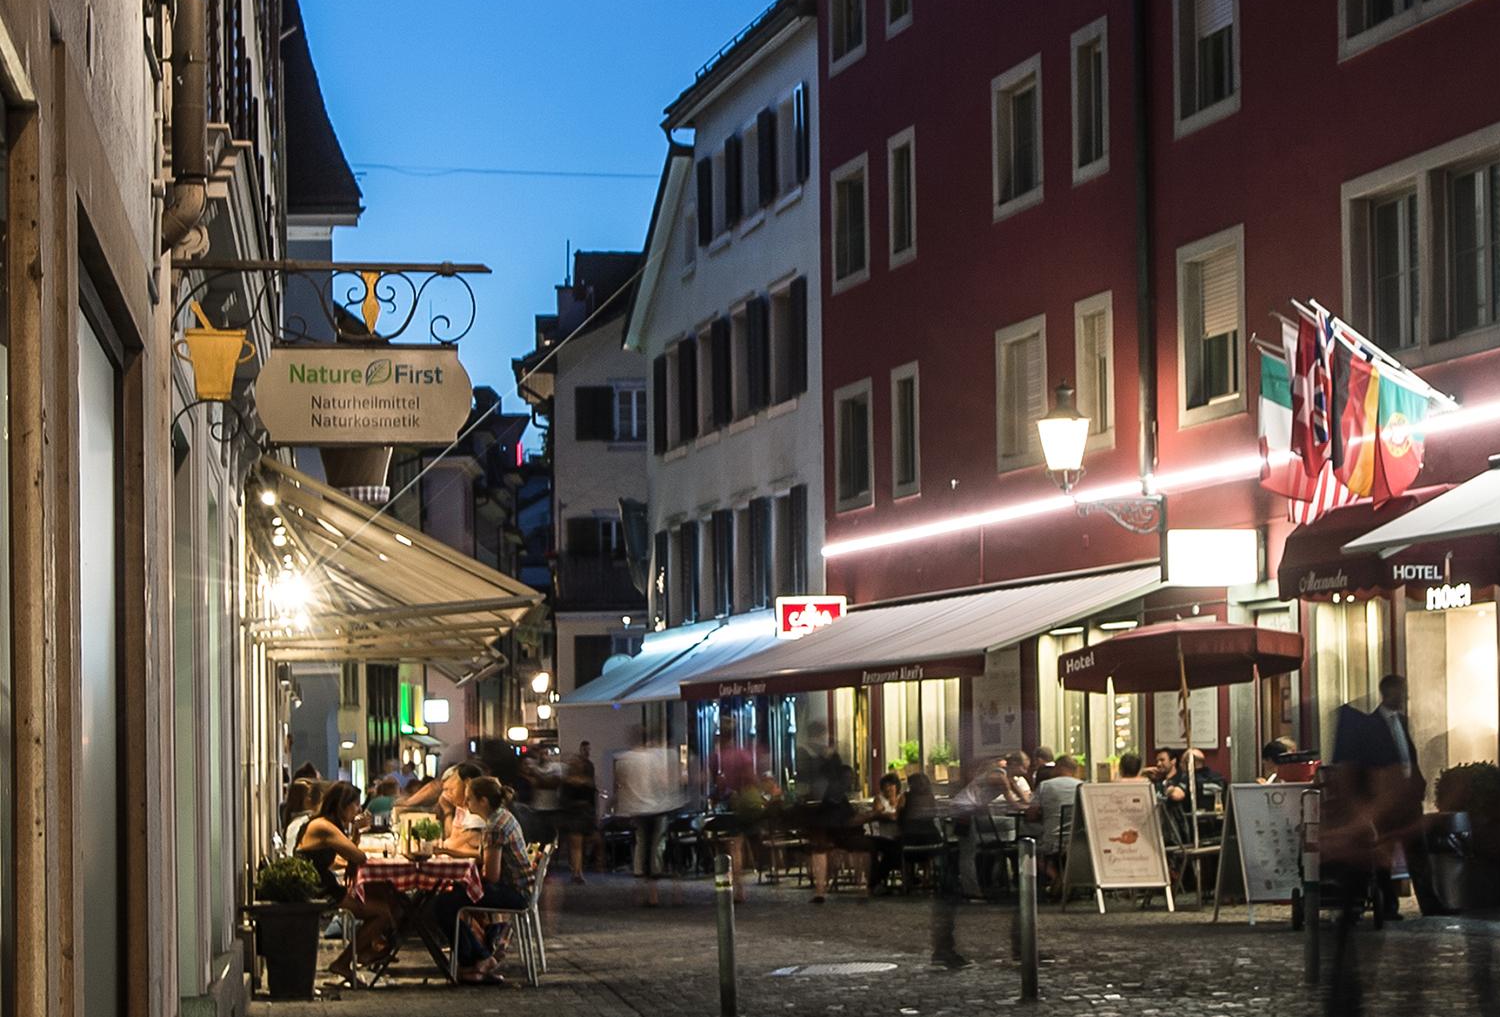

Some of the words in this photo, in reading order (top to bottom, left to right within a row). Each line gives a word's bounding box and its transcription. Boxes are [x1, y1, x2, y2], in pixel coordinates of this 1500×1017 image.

[289, 363, 363, 384] Nature
[395, 363, 443, 385] First
[311, 395, 420, 410] Naturheilmittel
[311, 413, 420, 428] Naturkosmetik
[1393, 564, 1443, 580] HOTEL
[1066, 651, 1095, 674] Hotel
